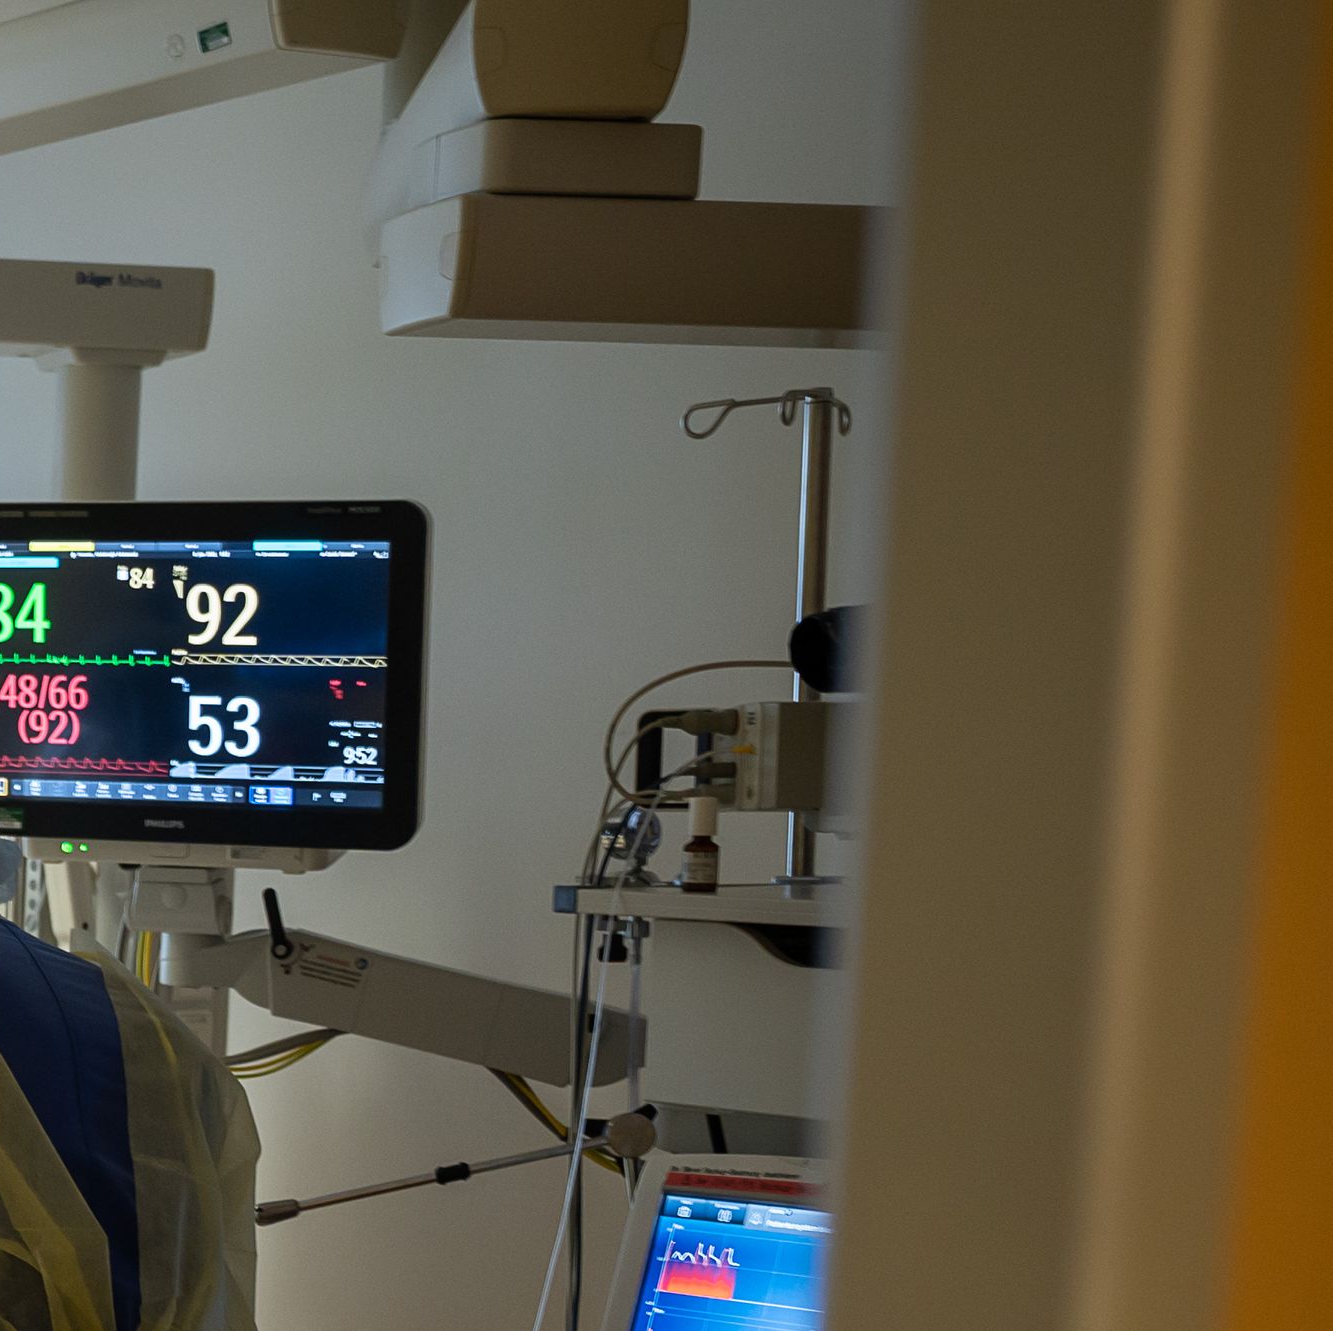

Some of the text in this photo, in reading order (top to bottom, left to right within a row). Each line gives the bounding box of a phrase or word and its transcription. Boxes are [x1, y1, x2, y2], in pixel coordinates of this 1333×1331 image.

[129, 567, 155, 589] 84
[185, 583, 259, 646] 92
[17, 709, 81, 745] (92)
[188, 695, 261, 757] 53
